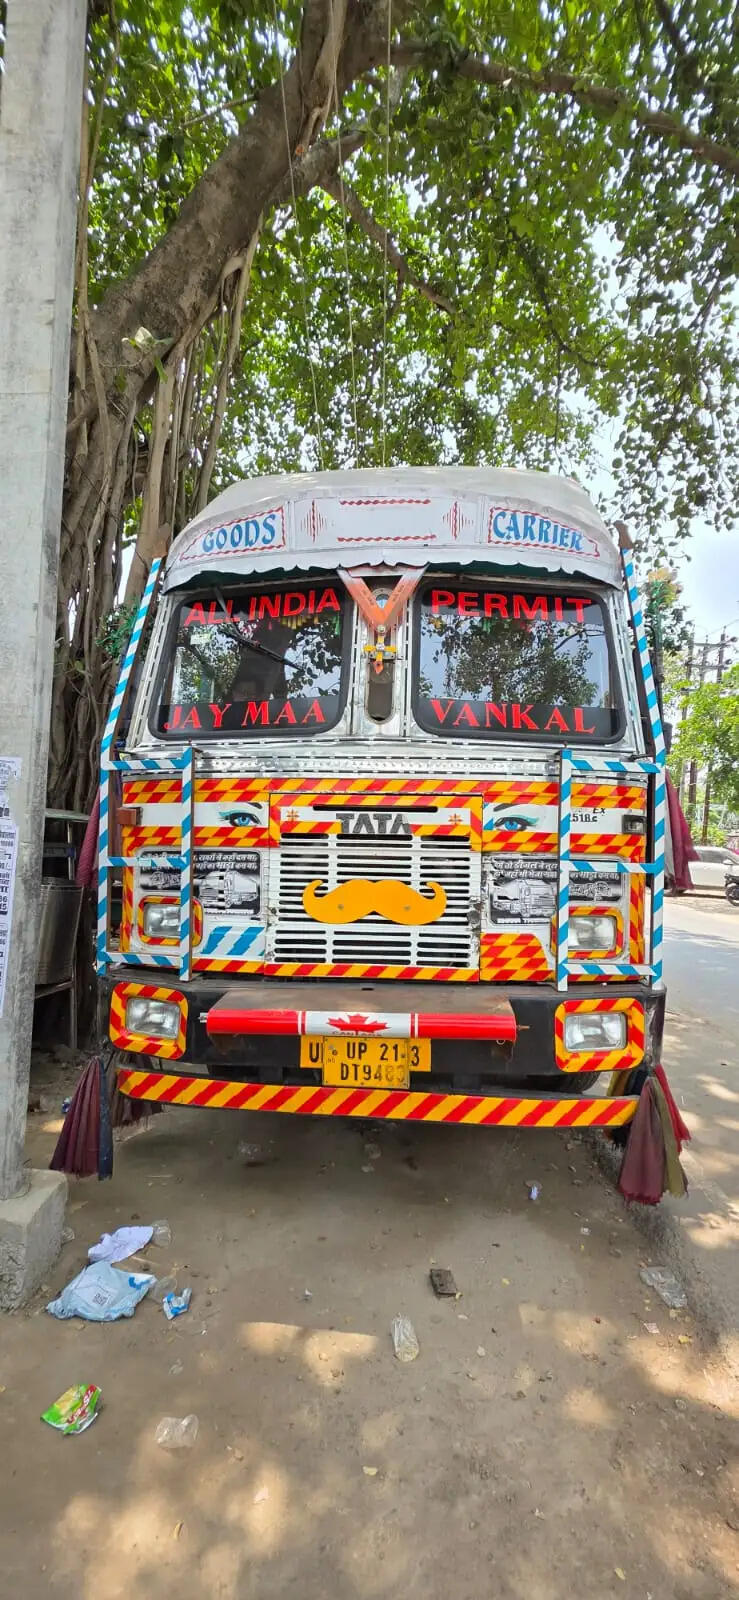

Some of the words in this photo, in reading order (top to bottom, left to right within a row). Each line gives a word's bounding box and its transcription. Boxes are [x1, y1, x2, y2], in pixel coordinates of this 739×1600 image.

[201, 512, 281, 552] GOODS
[492, 510, 585, 552] CARRIER
[184, 600, 240, 628] ALL
[248, 588, 341, 621] INDIA
[432, 590, 592, 622] PERMIT
[164, 703, 231, 730] JAY
[242, 700, 326, 727] MAA
[431, 699, 594, 734] VANKAL
[336, 813, 412, 834] TATA
[346, 1041, 368, 1061] UP
[379, 1043, 399, 1062] 21
